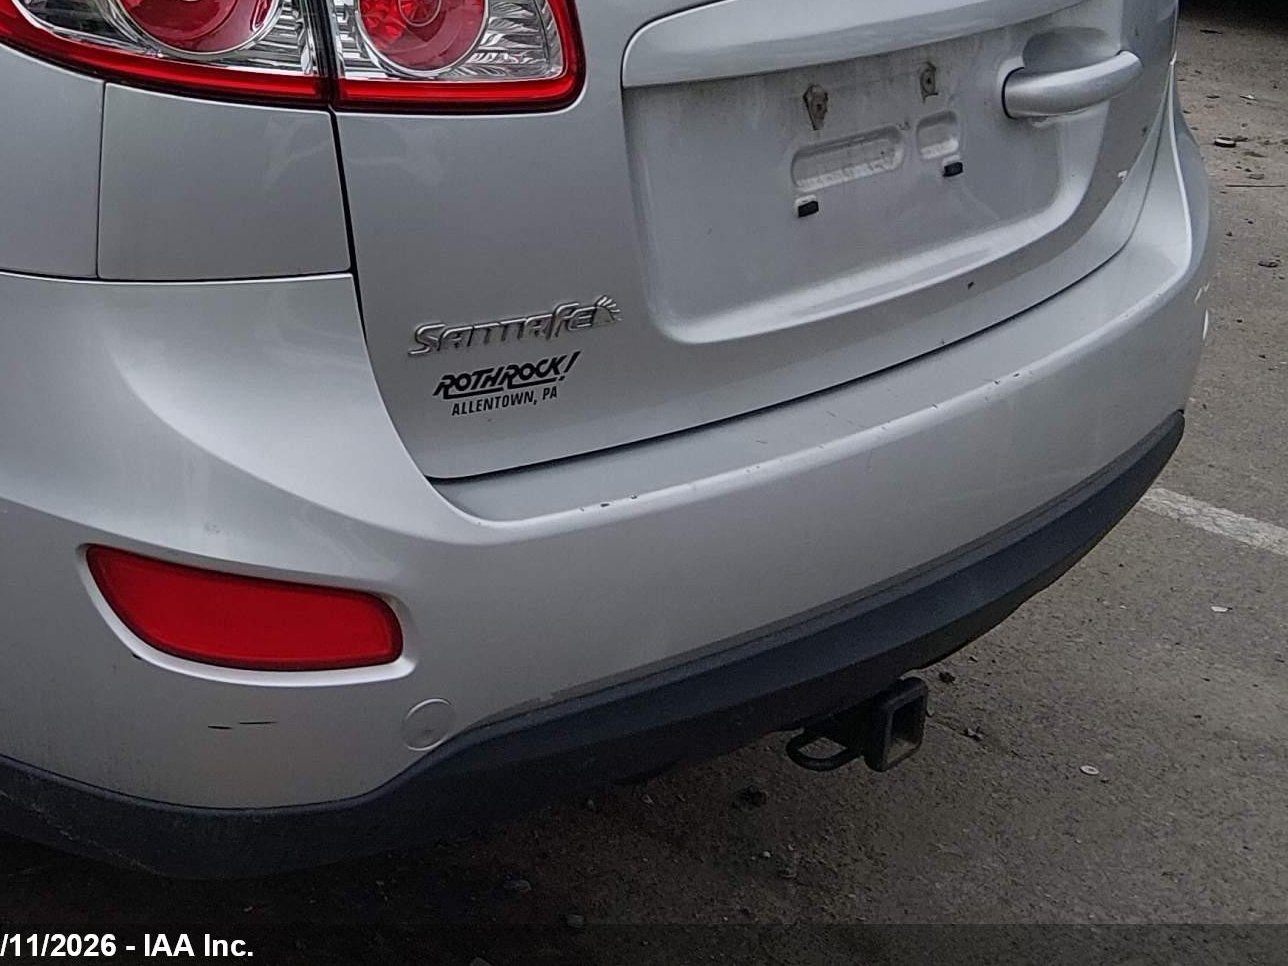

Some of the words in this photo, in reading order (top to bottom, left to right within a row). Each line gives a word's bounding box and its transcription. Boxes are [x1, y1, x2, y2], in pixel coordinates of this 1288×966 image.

[432, 351, 582, 400] ROTHROCK!
[451, 391, 537, 417] ALLENTOWN,
[542, 385, 558, 401] PA
